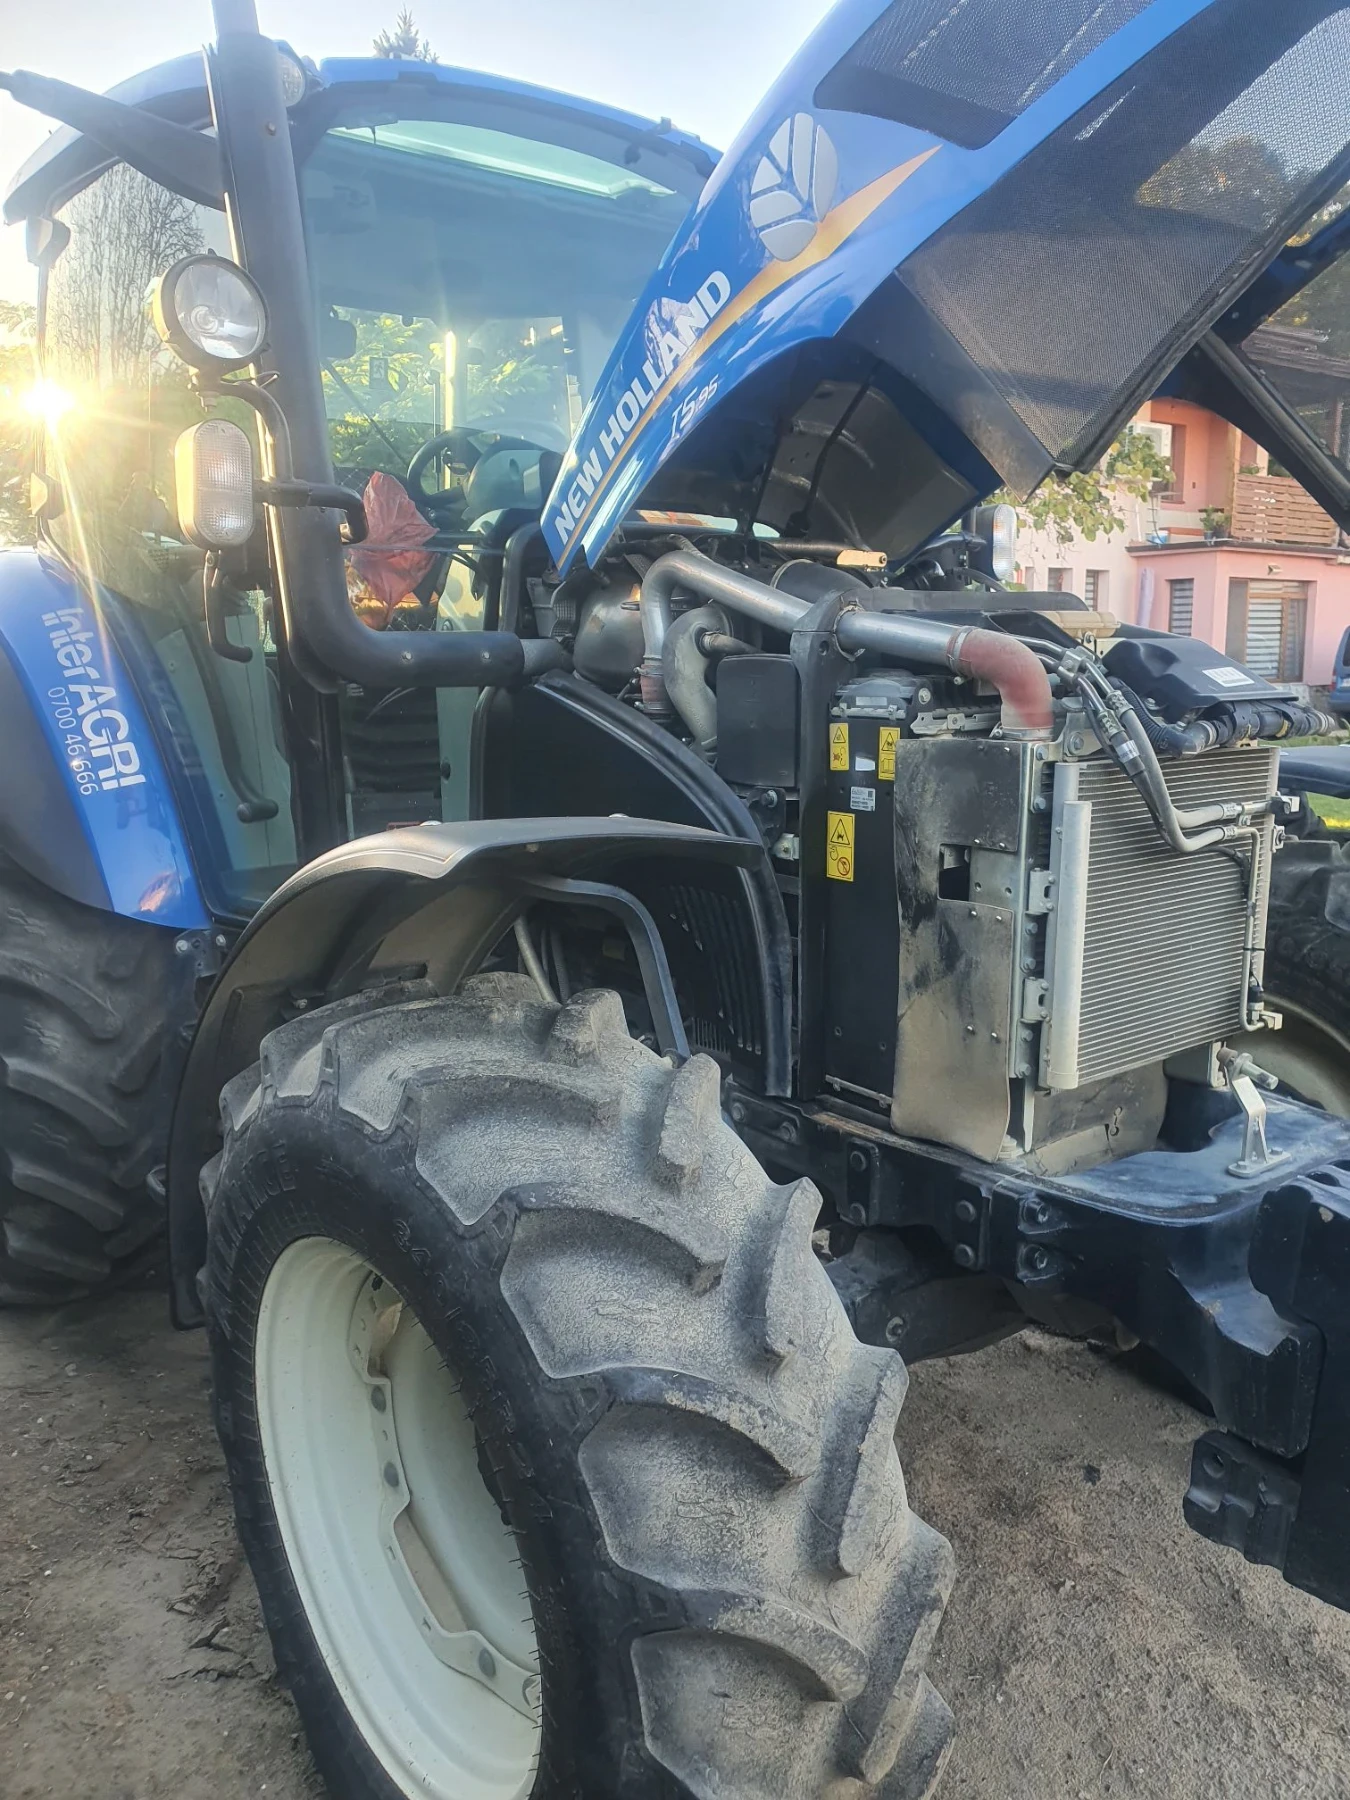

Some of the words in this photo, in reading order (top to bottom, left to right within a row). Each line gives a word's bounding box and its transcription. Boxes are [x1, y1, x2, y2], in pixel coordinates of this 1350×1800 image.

[553, 447, 605, 545] NEW
[600, 270, 731, 460] HOLLAND
[48, 687, 76, 729] 0700
[65, 734, 87, 756] 46
[70, 759, 99, 795] 666
